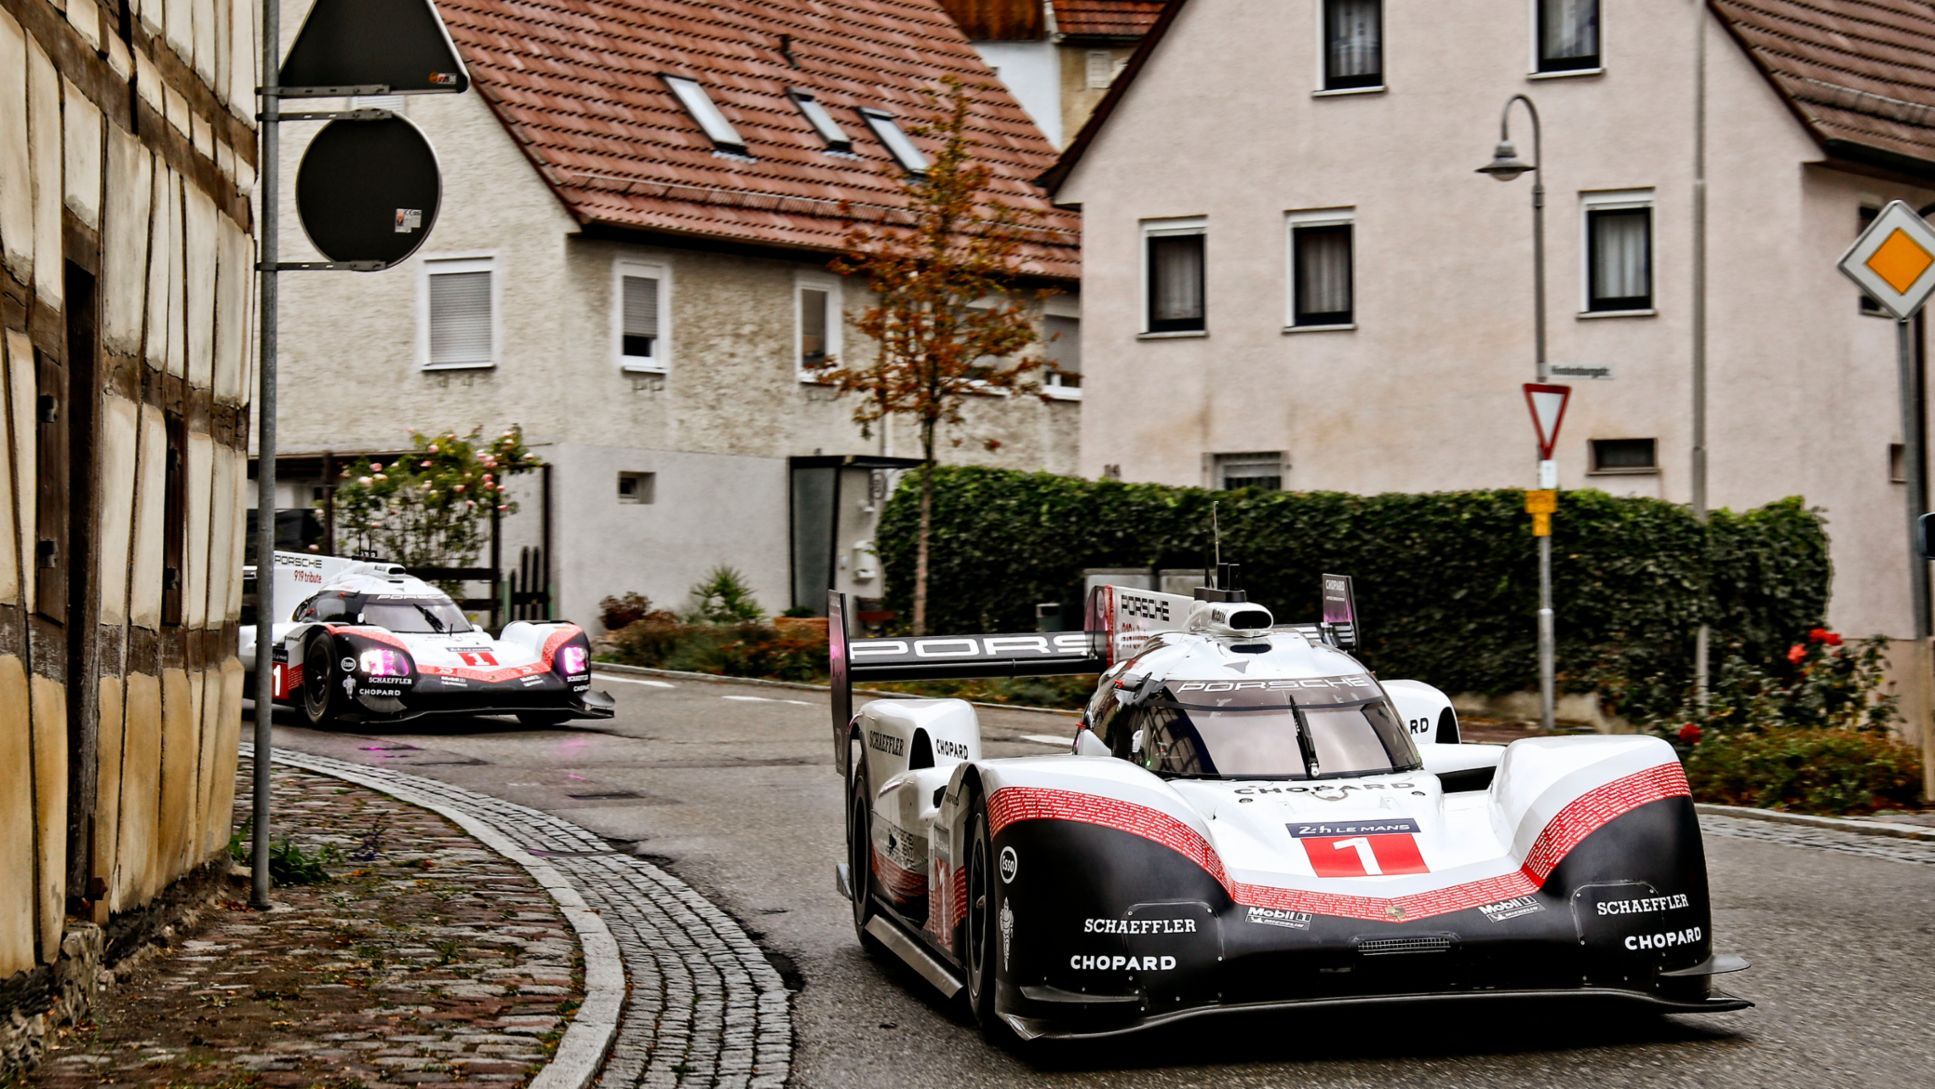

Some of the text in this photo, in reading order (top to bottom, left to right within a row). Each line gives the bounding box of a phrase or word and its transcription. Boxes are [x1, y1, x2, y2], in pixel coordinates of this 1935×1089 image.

[274, 555, 322, 569] PORSCHE
[293, 570, 322, 583] 919 tribute
[1121, 594, 1170, 622] PORSCHE
[849, 635, 1089, 661] PORS
[468, 652, 491, 666] 1
[273, 664, 282, 697] 1
[368, 676, 412, 685] SCHAEFFLER
[1177, 676, 1370, 694] PORSCHE
[358, 688, 402, 696] CHOPARD
[869, 730, 905, 757] SCHAEFFLER
[936, 739, 969, 760] CHOPARD
[1360, 824, 1411, 832] MANS
[1332, 836, 1384, 876] 1
[1479, 898, 1521, 914] Mobil
[1596, 893, 1690, 916] SCHAEFFLER
[1248, 906, 1295, 920] Mobil
[1084, 918, 1197, 934] SCHAEFFLER
[1624, 926, 1702, 951] CHOPARD
[1069, 955, 1177, 971] CHOPARD
